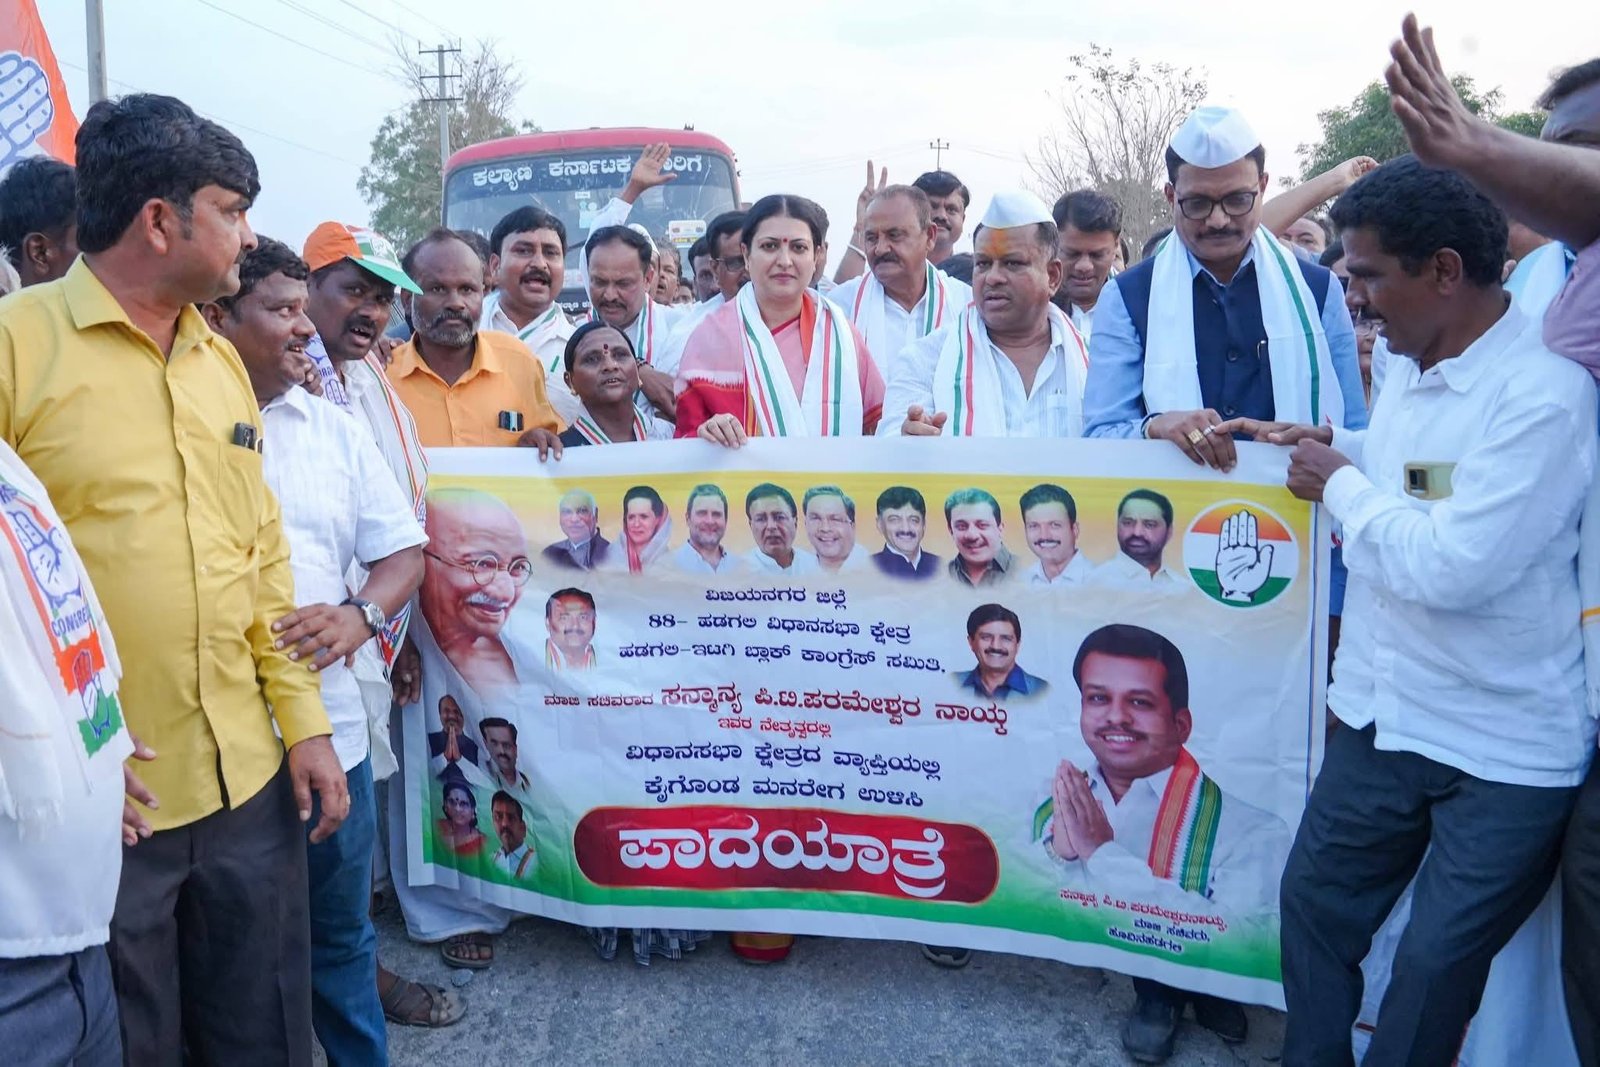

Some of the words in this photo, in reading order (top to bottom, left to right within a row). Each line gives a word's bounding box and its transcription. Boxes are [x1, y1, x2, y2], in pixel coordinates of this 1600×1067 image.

[473, 165, 533, 191] ಕಲ್ಯಾಣ
[549, 155, 632, 177] ಕರ್ನಾಟಕ
[705, 586, 806, 602] ವಿಜಯನಗರ
[816, 589, 847, 610] ಜಿಲ್ಲೆ
[697, 612, 757, 629] ಹಡಗಲಿ
[767, 616, 860, 637] ವಿಧಾನಸಭಾ
[870, 621, 912, 645] ಕ್ಷೇತ್ರ
[744, 645, 791, 663] ಬ್ಲಾಕ್
[801, 648, 876, 670] ಕಾಂಗ್ರೆಸ್
[544, 693, 580, 706] ಮಾಜಿ
[587, 693, 654, 707] ಸಚಿವರಾದ
[661, 681, 744, 714] ಸನ್ಮಾನ್ಯ
[718, 716, 753, 729] ಇವರ
[760, 717, 832, 739] ನೇತೃತ್ವದಲ್ಲಿ
[626, 741, 743, 762] ವಿಧಾನಸಭಾ
[755, 742, 821, 768] ಕ್ಷೇತ್ರದ
[833, 751, 942, 781] ವ್ಯಾಪ್ತಿಯಲ್ಲಿ
[645, 775, 740, 803] ಕೈಗೊಂಡ
[752, 776, 845, 800] ಮನರೇಗ
[858, 786, 924, 807] ಉಳಿಸಿ
[618, 814, 946, 898] ಪಾದಯಾತ್ರೆ
